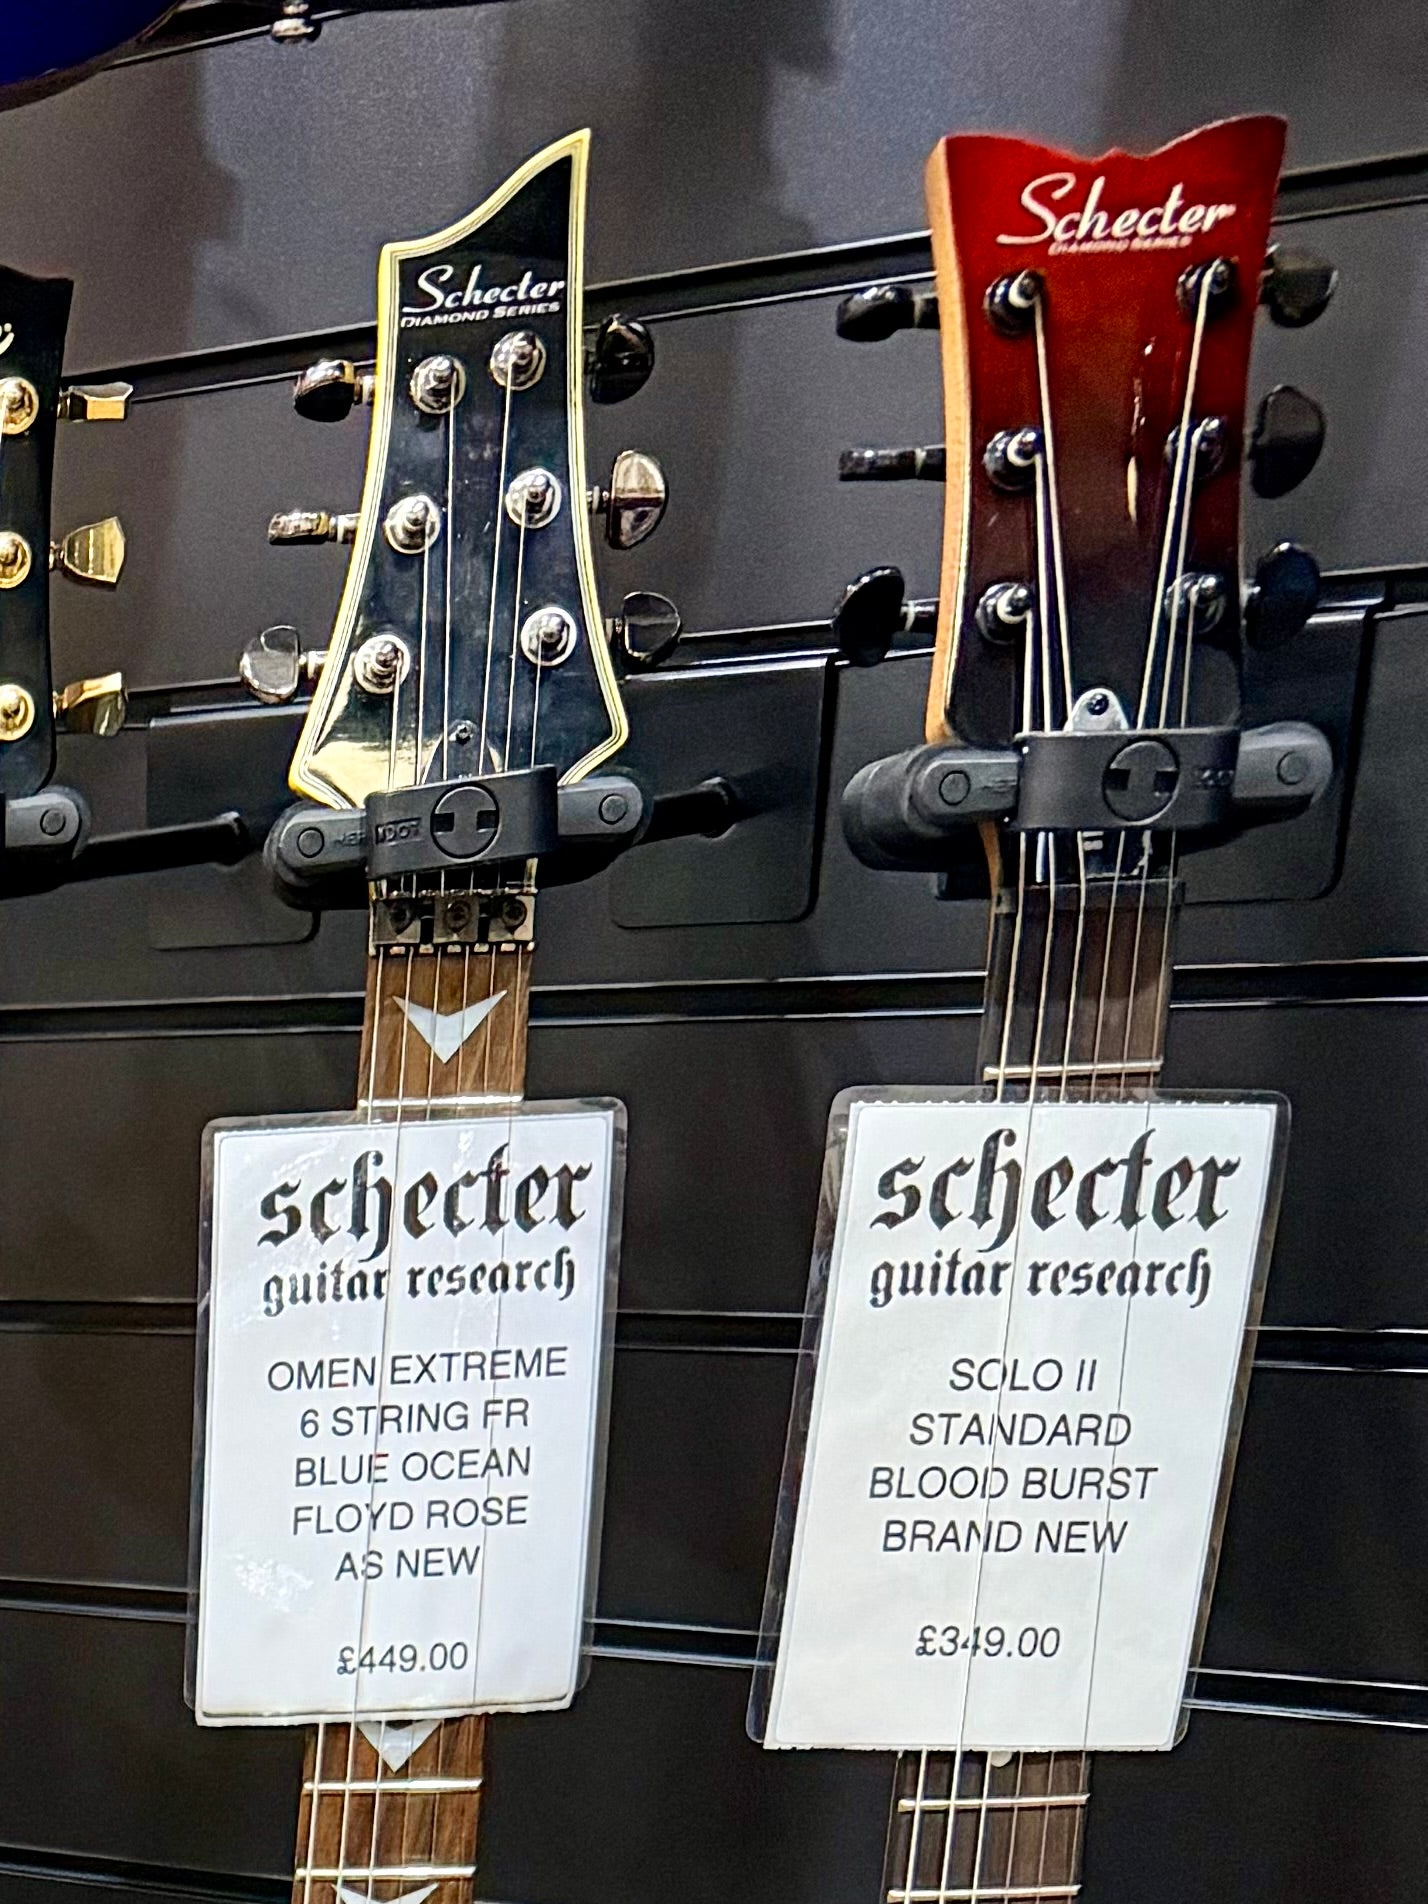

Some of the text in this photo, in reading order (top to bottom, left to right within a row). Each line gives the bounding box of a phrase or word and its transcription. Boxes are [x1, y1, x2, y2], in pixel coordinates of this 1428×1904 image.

[996, 172, 1237, 245] Schecter
[402, 264, 566, 313] Schecter
[401, 302, 560, 328] DIAMOND SERIES
[257, 1142, 594, 1263] schecter
[870, 1127, 1242, 1254] schecter
[263, 1246, 576, 1317] guitar research
[870, 1248, 1212, 1309] guitar research
[267, 1347, 568, 1392] OMEN EXTREME
[948, 1359, 1097, 1392] SOLO II
[299, 1398, 530, 1439] 6 STRING FR
[909, 1413, 1132, 1447] STANDARD
[295, 1447, 531, 1488] BLUE OCEAN
[869, 1467, 1158, 1499] BLOOD BURST
[293, 1496, 529, 1536] FLOYD ROSE
[882, 1521, 1128, 1553] BRAND NEW
[336, 1547, 481, 1581] AS NEW
[337, 1641, 468, 1674] £449.00
[916, 1626, 1061, 1659] £349.00
